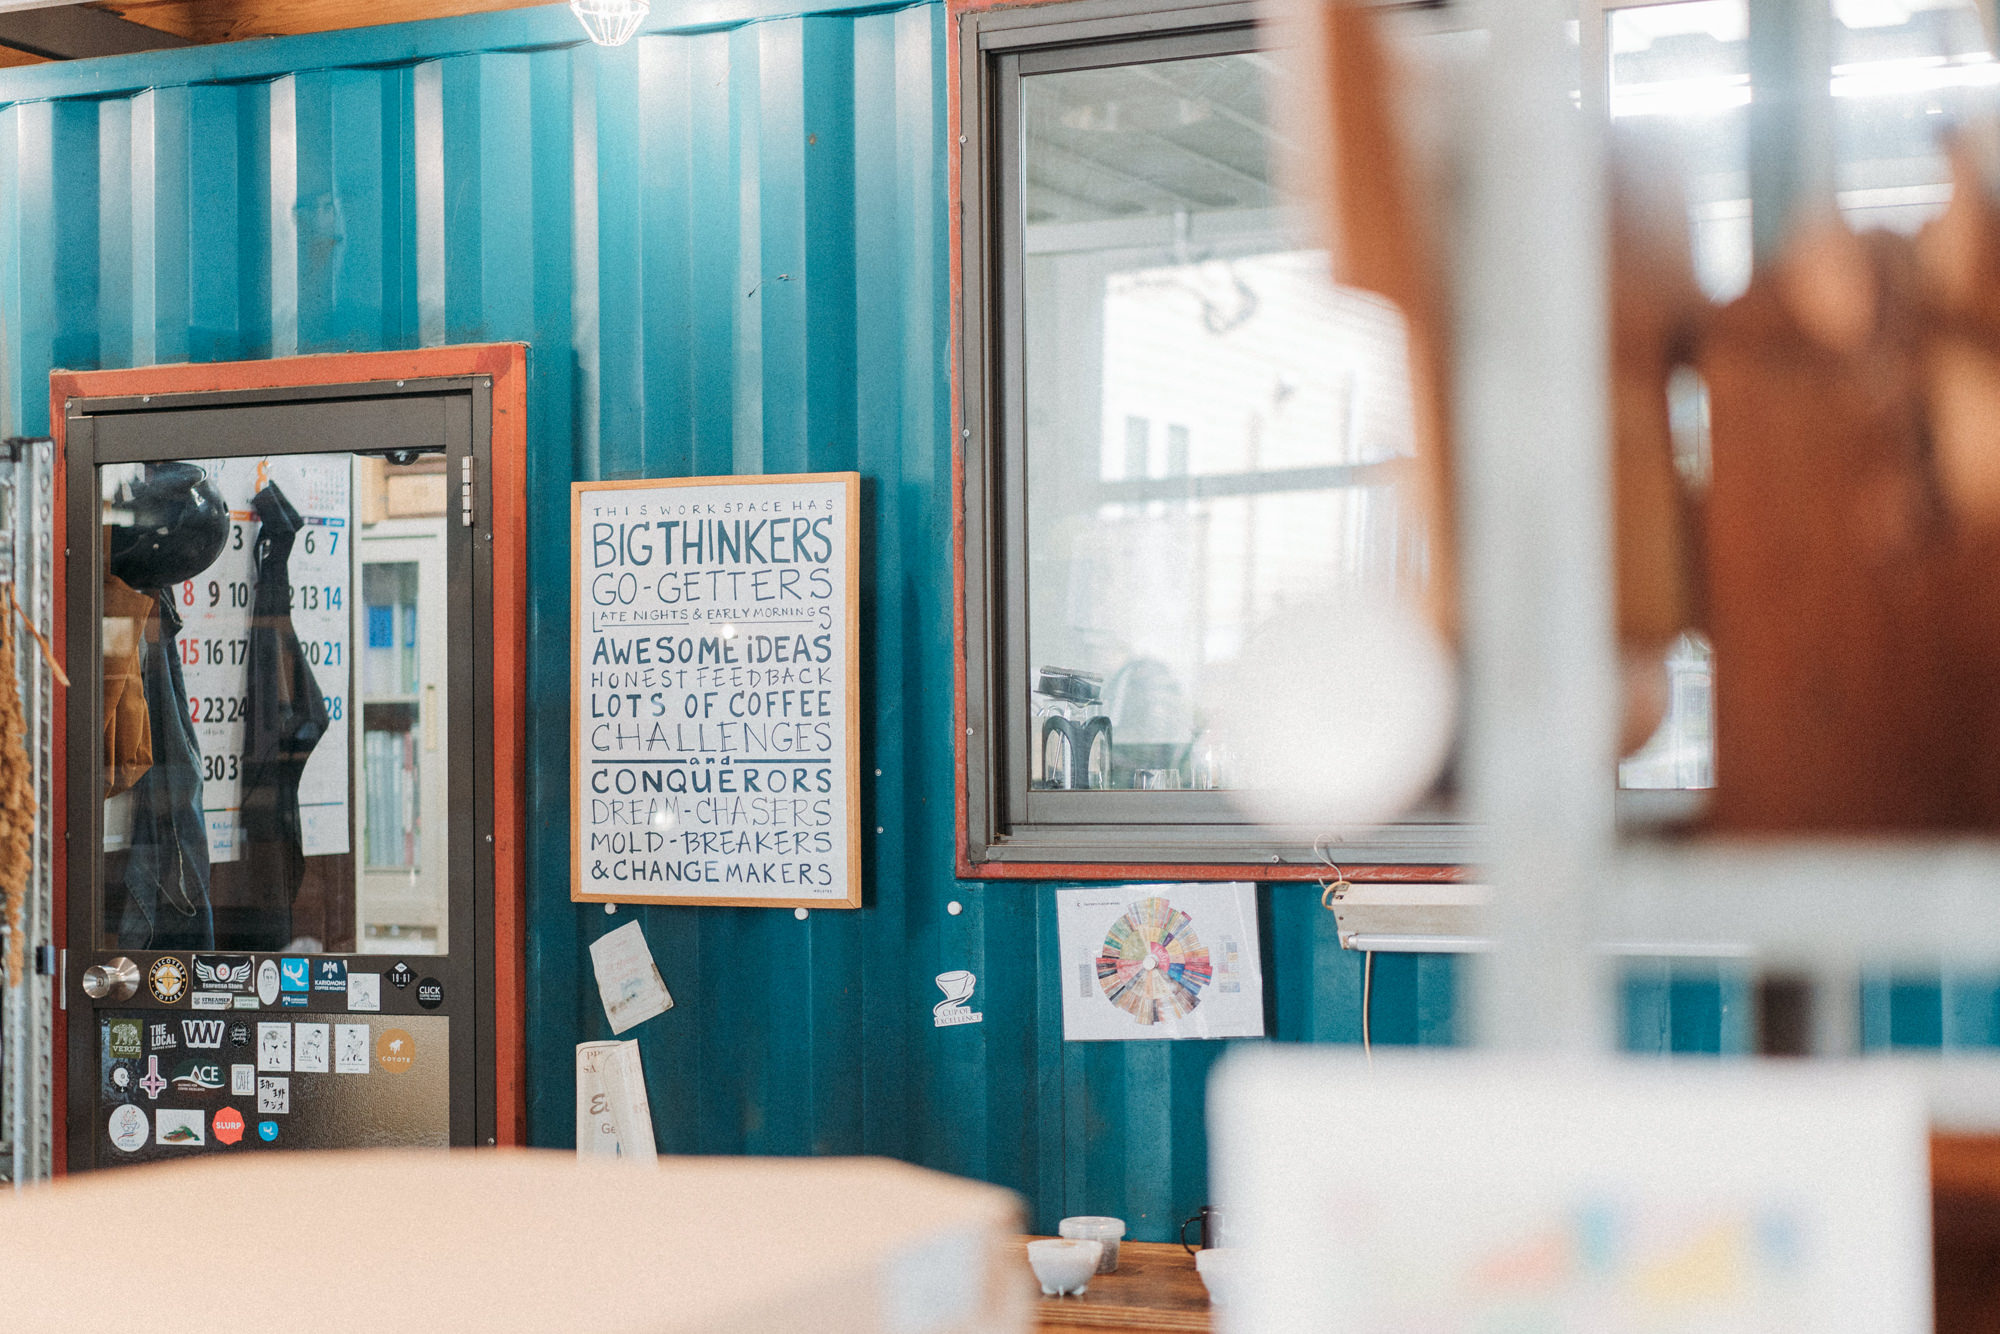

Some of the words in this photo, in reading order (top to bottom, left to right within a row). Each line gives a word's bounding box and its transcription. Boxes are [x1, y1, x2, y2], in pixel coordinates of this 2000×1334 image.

[594, 505, 648, 517] THIS
[792, 499, 833, 511] HAS
[232, 525, 243, 550] 3
[305, 530, 315, 554] 6
[329, 532, 339, 555] 7
[593, 521, 653, 568] BIG
[656, 515, 833, 566] THINKERS
[183, 579, 195, 606] 8
[208, 581, 220, 607] 9
[229, 582, 248, 607] 10
[301, 586, 319, 610] 13
[323, 586, 343, 611] 14
[592, 568, 833, 606] GO-GETTERS
[593, 611, 627, 632] LATE
[633, 608, 689, 621] NIGHTS
[692, 608, 703, 620] &
[179, 639, 200, 665] 15
[204, 639, 224, 665] 16
[228, 640, 248, 665] 17
[323, 641, 342, 666] 21
[592, 636, 739, 665] AWESOME
[592, 669, 688, 689] HONEST
[697, 666, 832, 688] FEEDBACK
[189, 697, 200, 723] 2
[203, 697, 224, 723] 23
[227, 697, 248, 722] 24
[592, 692, 666, 718] LOTS
[685, 692, 718, 718] OF
[729, 690, 831, 717] COFFEE
[592, 721, 832, 752] CHALLENGES
[203, 754, 225, 781] 30
[689, 755, 730, 766] and
[592, 768, 832, 794] CONQUERORS
[592, 796, 832, 826] DREAM-CHASERS
[591, 830, 832, 855] MOLD-BREAKERS
[419, 986, 440, 994] CLICK
[150, 1023, 167, 1036] THE
[151, 1033, 176, 1047] LOCAL
[190, 1065, 219, 1081] ACE
[215, 1122, 241, 1130] SLURP
